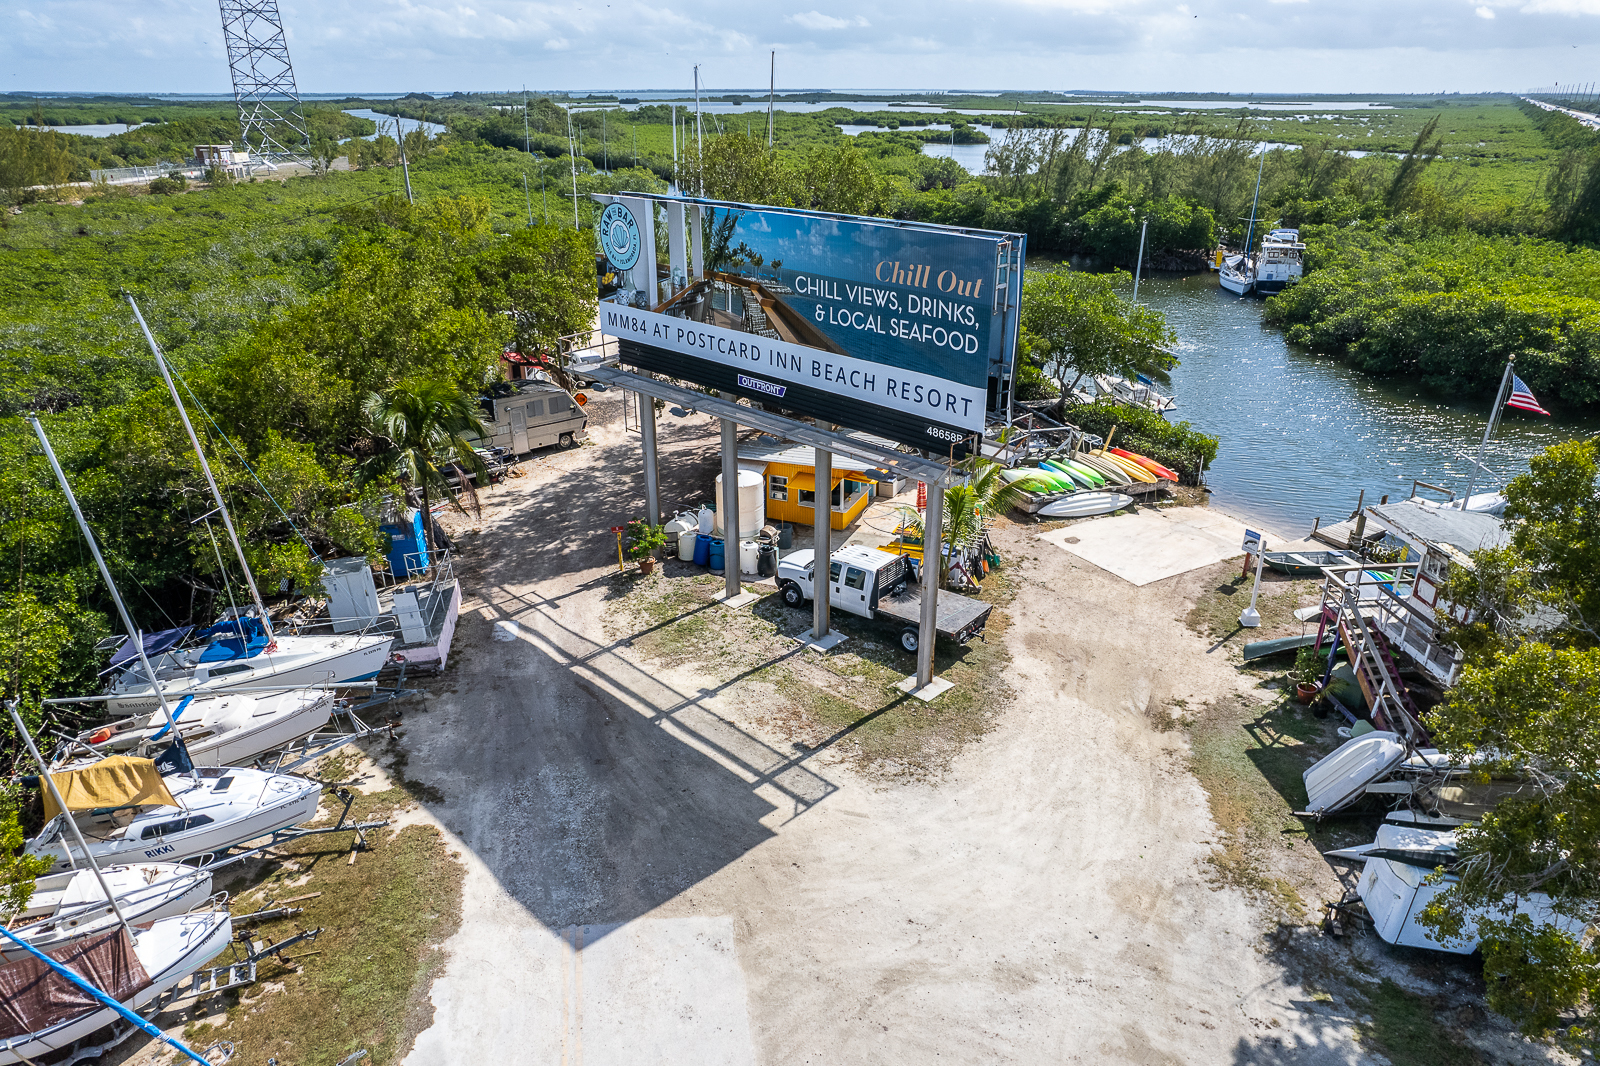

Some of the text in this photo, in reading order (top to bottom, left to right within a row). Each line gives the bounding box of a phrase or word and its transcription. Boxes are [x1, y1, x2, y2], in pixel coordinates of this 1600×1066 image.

[603, 210, 612, 236] RAW
[618, 207, 634, 228] BAR
[875, 260, 984, 299] Chill Out
[795, 275, 980, 331] CHILL VIEWS, DRINKS,
[815, 304, 979, 354] & LOCAL SEAFOOD
[607, 311, 973, 417] MM84 AT POSTCARD INN BEACH RESORT
[742, 377, 781, 395] OUTFRONT
[144, 844, 176, 858] RIKKI
